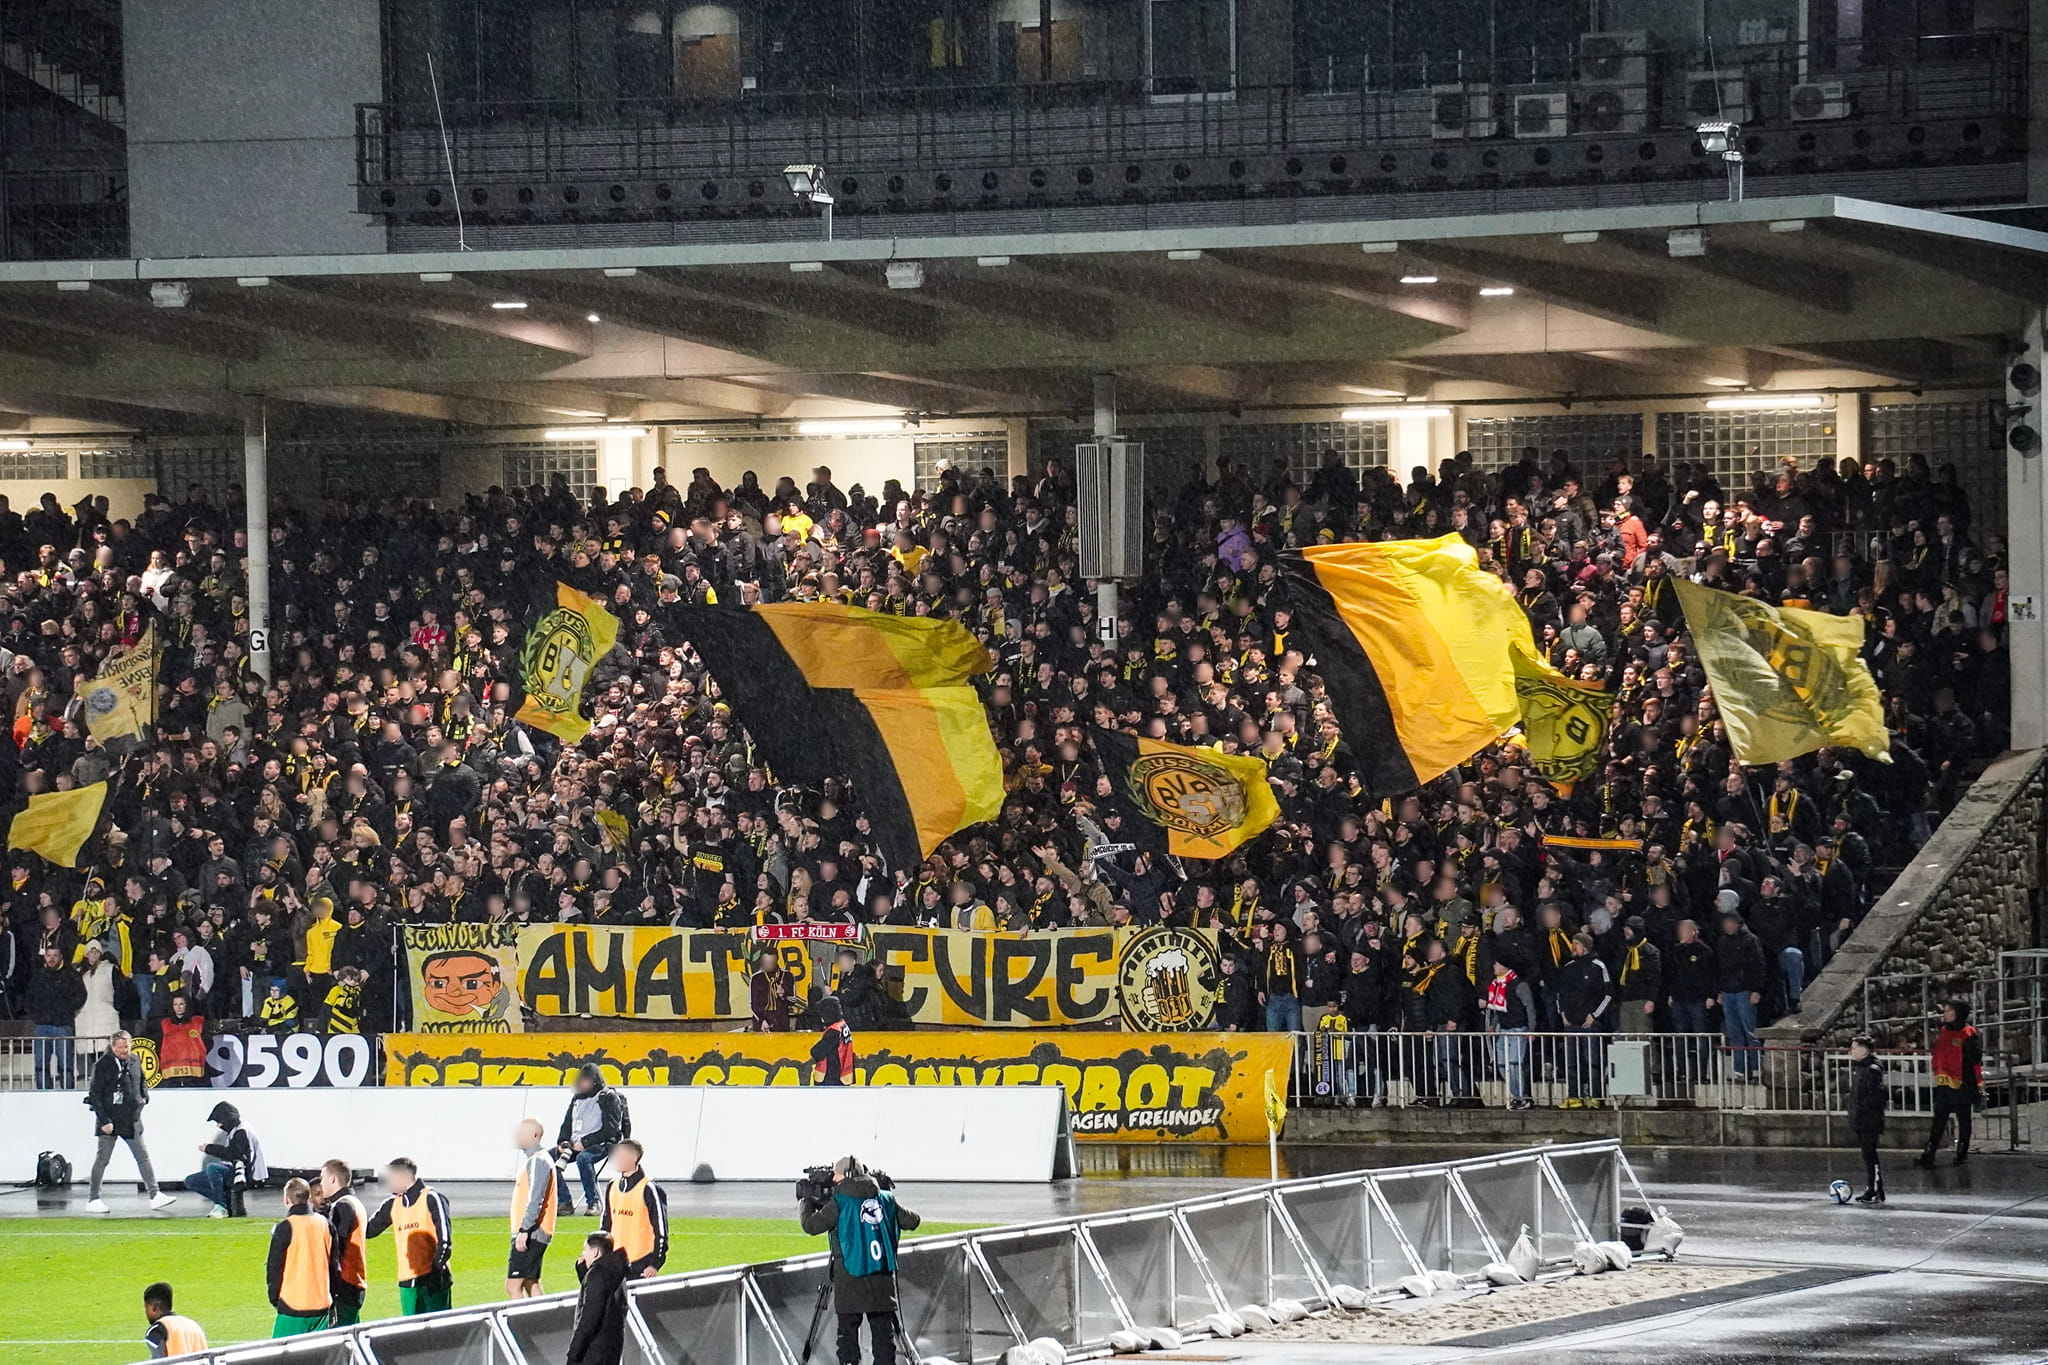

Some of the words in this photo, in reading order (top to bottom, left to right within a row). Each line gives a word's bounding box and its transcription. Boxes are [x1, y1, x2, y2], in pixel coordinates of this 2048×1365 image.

[1098, 617, 1114, 638] H
[250, 630, 265, 651] G
[778, 927, 788, 938] 1.
[791, 926, 805, 938] FC
[807, 925, 837, 938] KÖLN
[206, 1033, 370, 1088] 9590
[1068, 1111, 1118, 1130] AGEN
[1128, 1108, 1221, 1128] FREUNDE!
[617, 1208, 634, 1217] JAKO
[403, 1221, 420, 1230] JAKO
